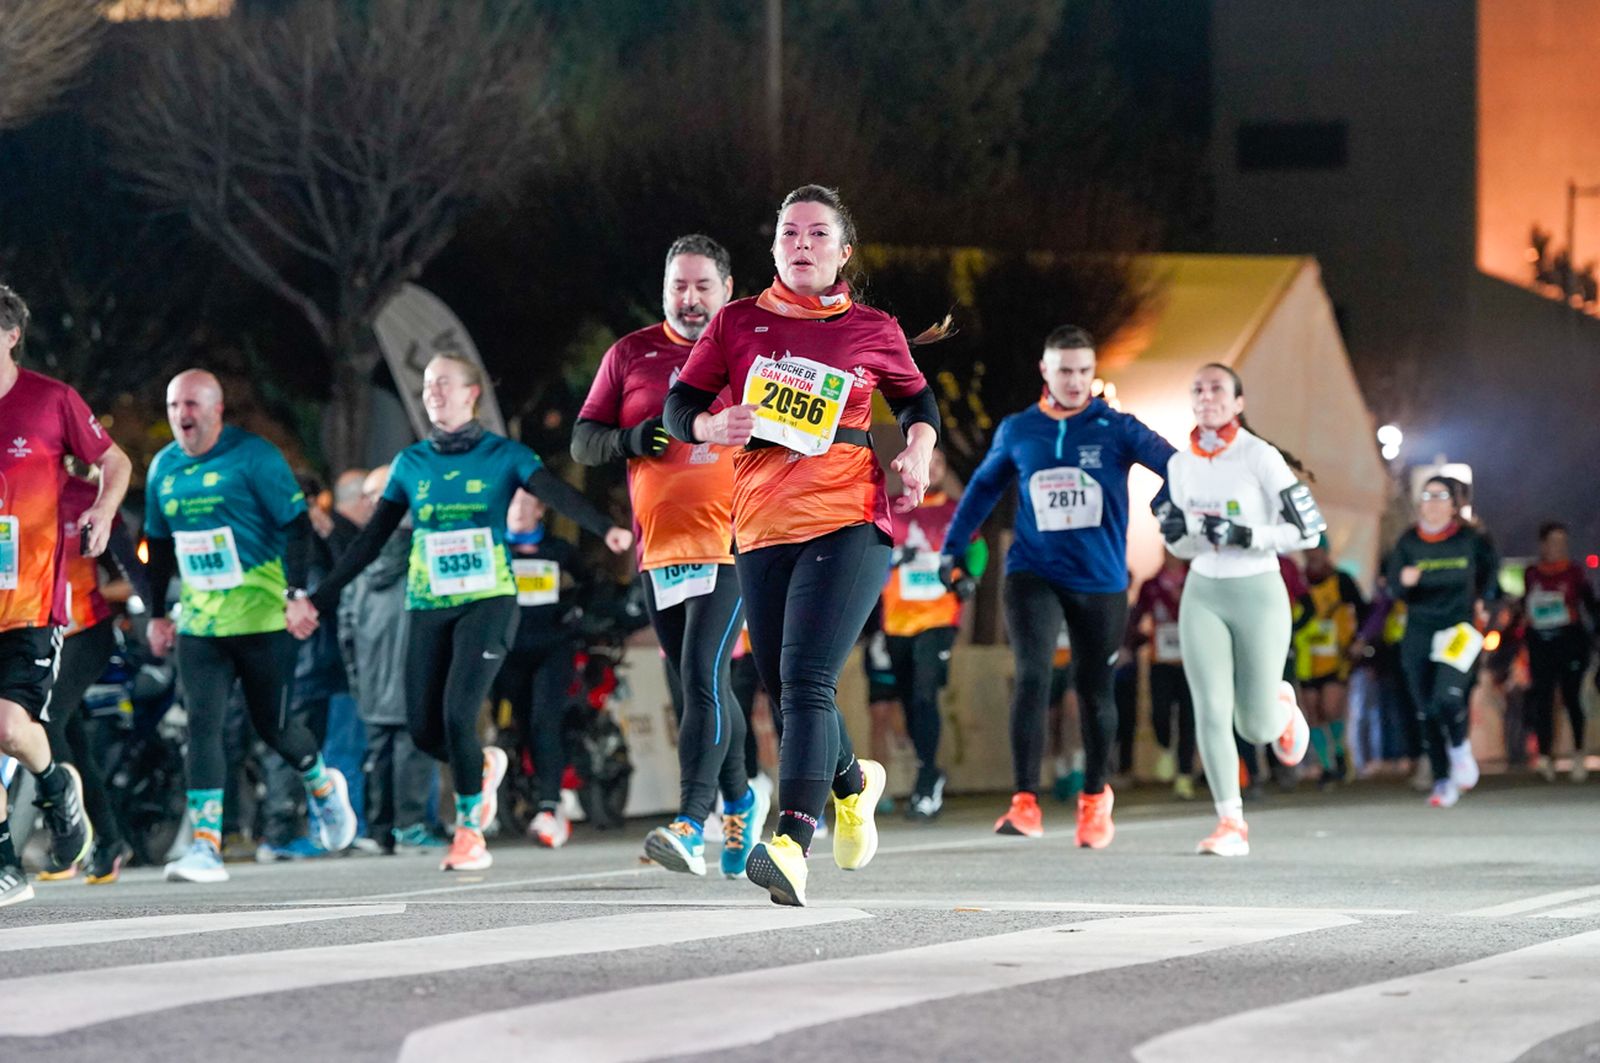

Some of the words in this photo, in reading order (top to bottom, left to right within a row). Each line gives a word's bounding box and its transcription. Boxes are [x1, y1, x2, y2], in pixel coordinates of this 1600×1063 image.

[760, 368, 781, 381] SAN
[774, 362, 804, 377] NOCHE
[804, 370, 817, 381] DE
[760, 381, 827, 425] 2056
[1048, 490, 1086, 508] 2871
[438, 553, 482, 573] 5336
